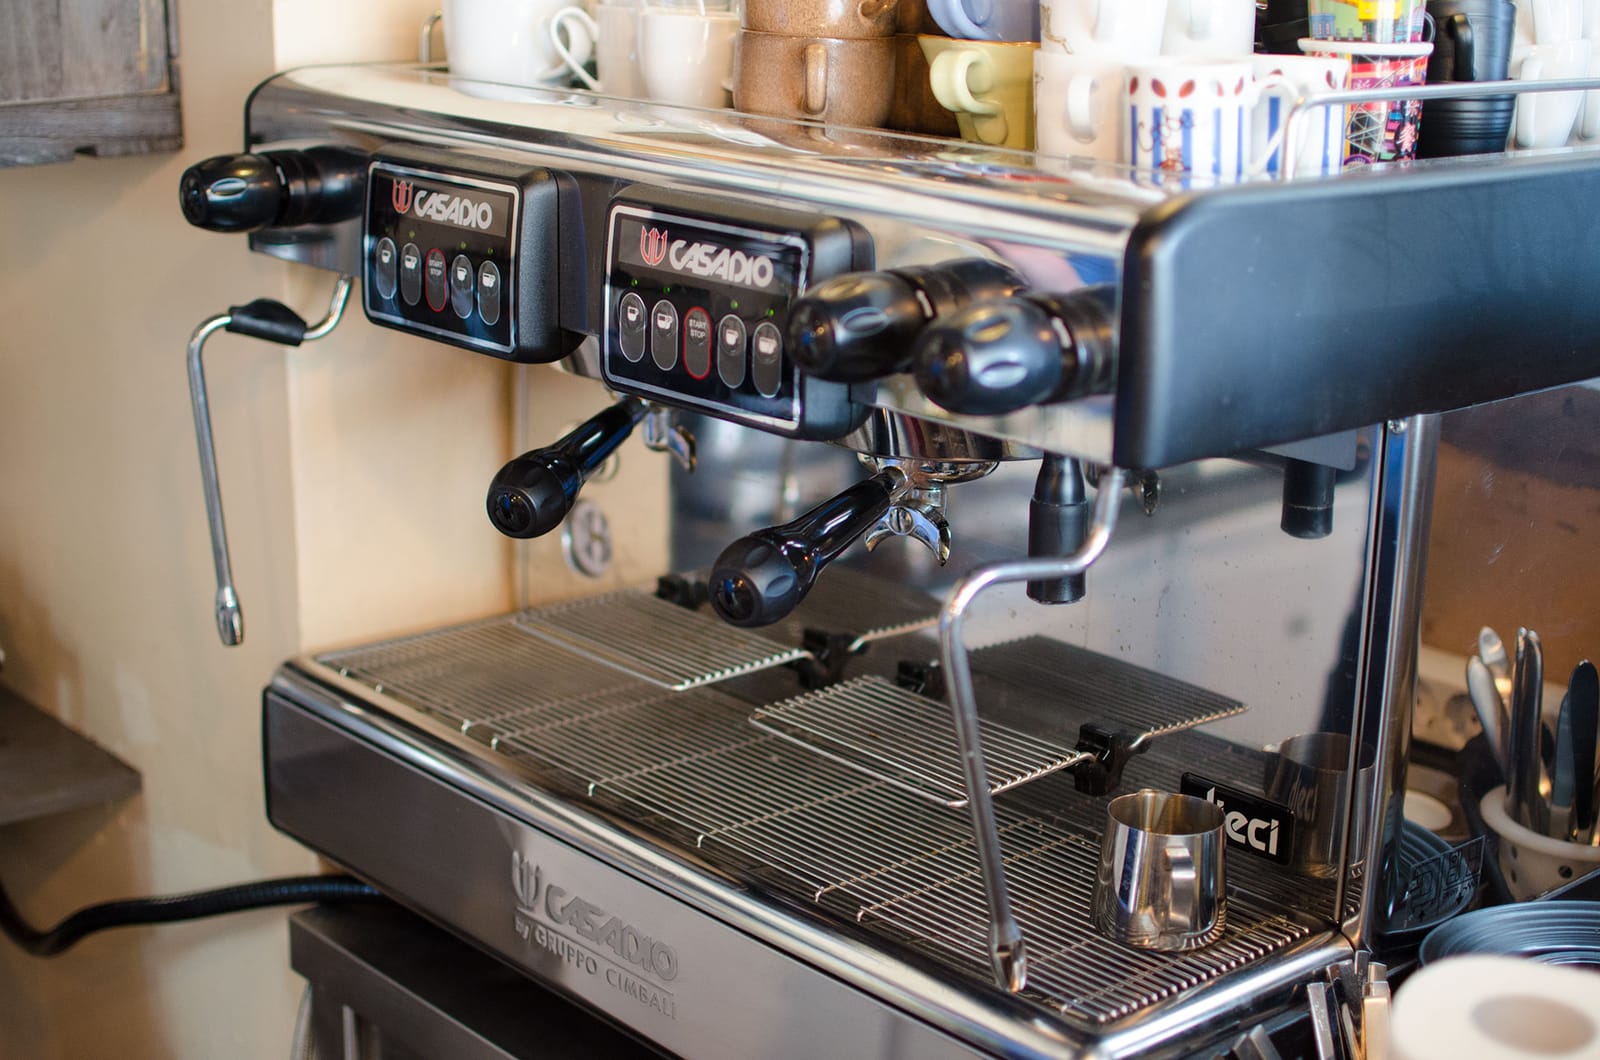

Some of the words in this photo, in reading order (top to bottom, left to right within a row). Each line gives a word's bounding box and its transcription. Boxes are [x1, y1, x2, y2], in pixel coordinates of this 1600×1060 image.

[413, 189, 493, 230] CASADIO
[669, 239, 774, 288] CASADIO
[689, 319, 707, 329] START
[690, 328, 706, 339] STOP
[1206, 786, 1280, 856] eci
[545, 884, 678, 981] CASADIO
[535, 924, 598, 975] GRUPPO
[606, 968, 677, 1020] CIMBALI
